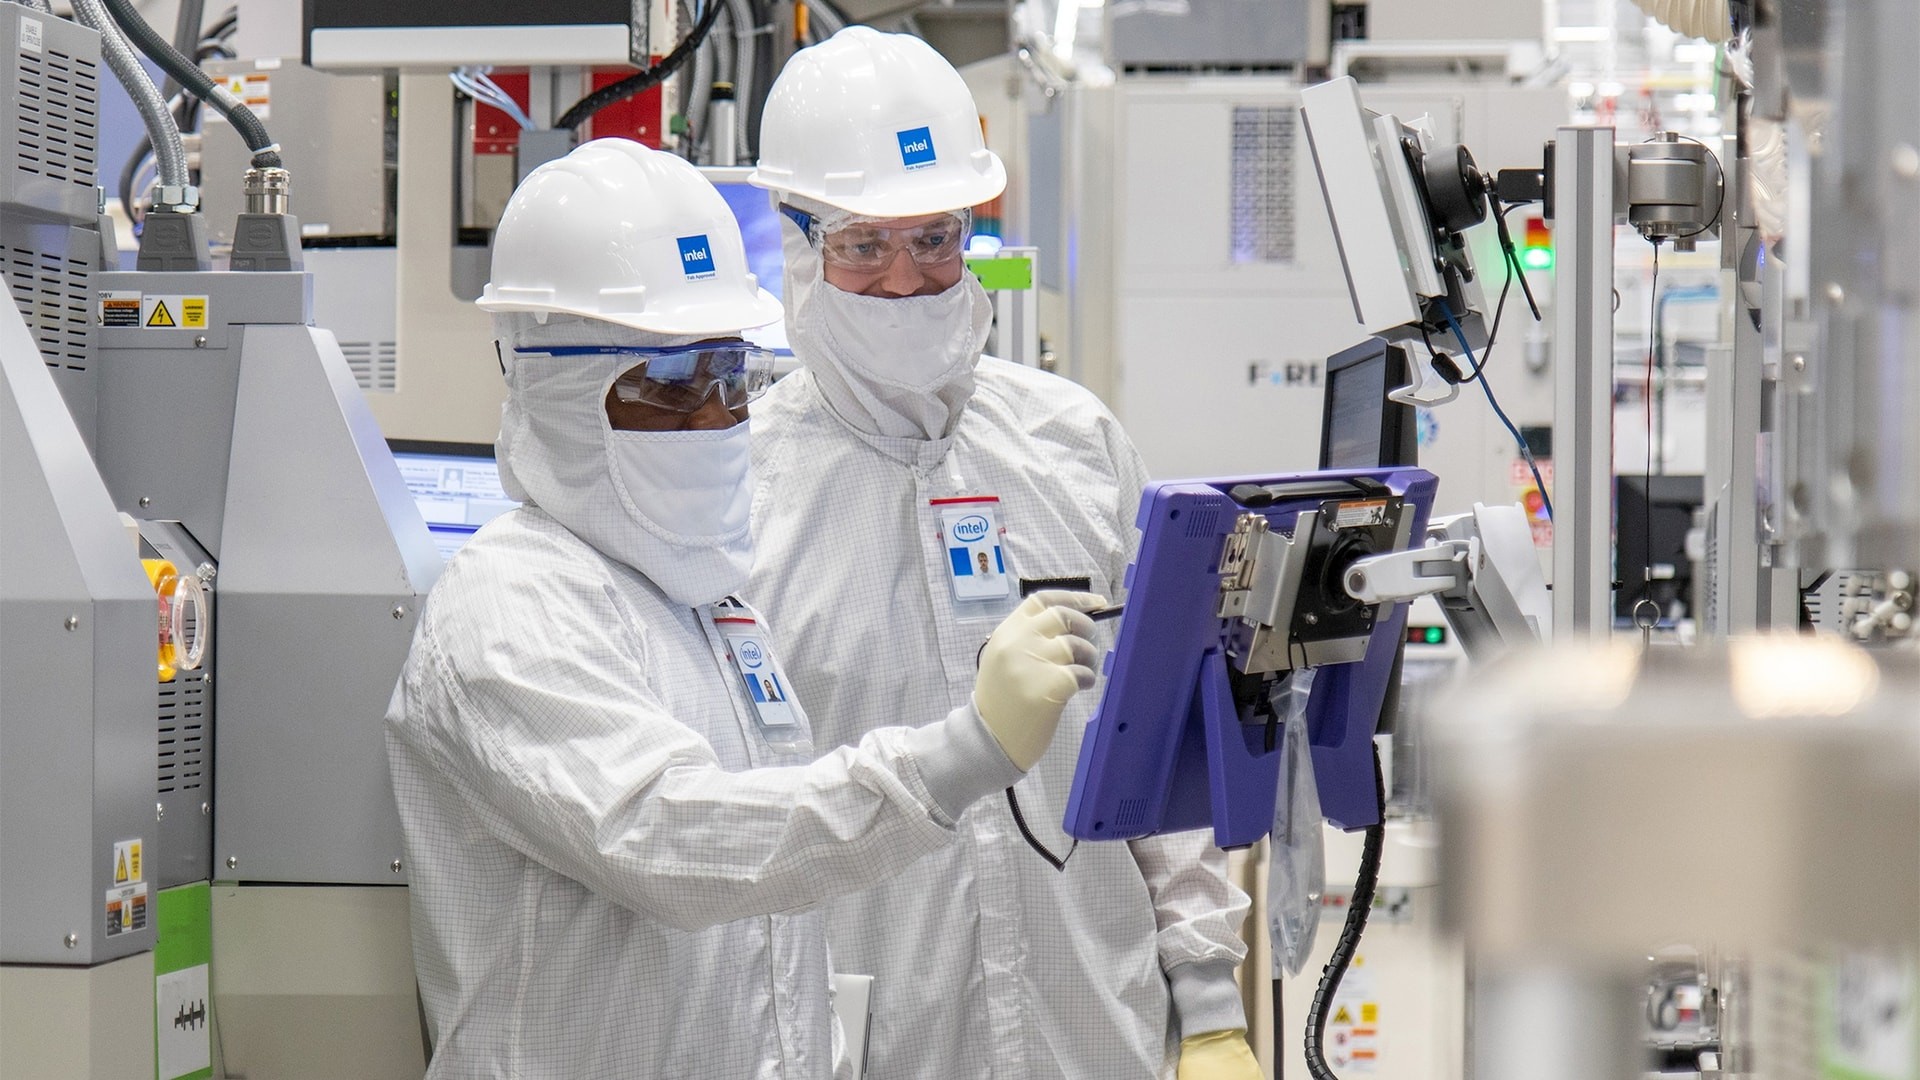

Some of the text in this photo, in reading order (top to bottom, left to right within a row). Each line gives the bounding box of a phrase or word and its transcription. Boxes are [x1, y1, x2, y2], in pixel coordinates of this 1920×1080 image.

[904, 139, 928, 153] intel
[684, 248, 707, 261] intel
[957, 521, 984, 535] intel
[740, 647, 760, 660] intel
